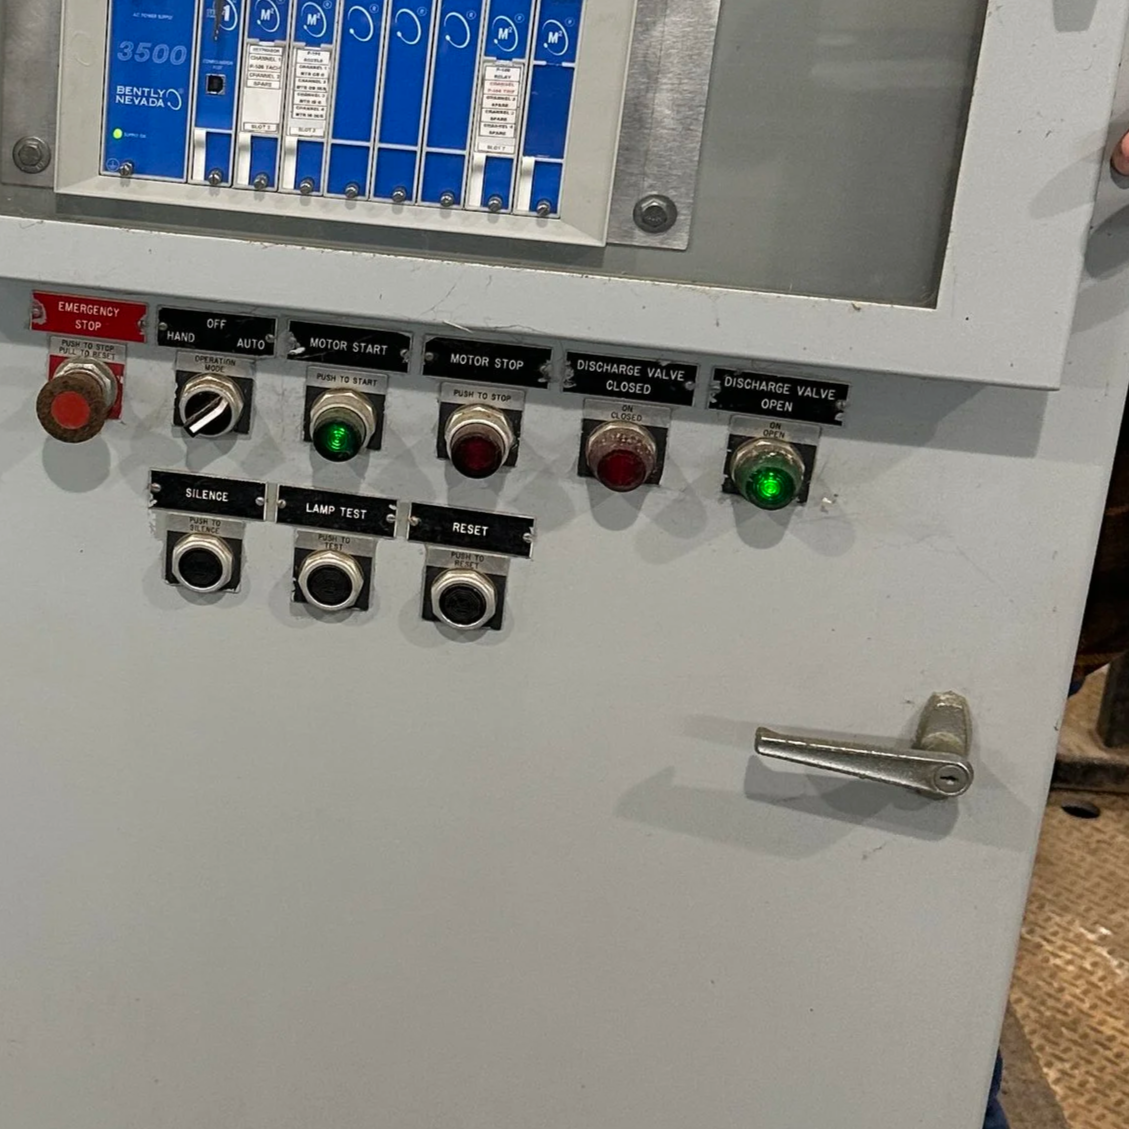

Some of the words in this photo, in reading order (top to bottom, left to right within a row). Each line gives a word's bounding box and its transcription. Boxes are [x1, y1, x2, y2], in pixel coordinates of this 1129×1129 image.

[117, 40, 188, 66] 3500
[116, 85, 166, 98] BENTLY
[116, 95, 164, 108] NEVADA
[58, 301, 120, 318] EMERGENCY
[75, 319, 102, 332] STOP
[207, 318, 226, 330] OFF
[167, 330, 195, 342] HAND
[62, 340, 81, 348] PUSH
[96, 343, 114, 352] STOP
[236, 338, 266, 350] AUTO
[310, 337, 348, 352] MOTOR
[352, 342, 388, 356] START
[59, 346, 76, 355] PULL
[79, 348, 90, 356] TO
[92, 350, 116, 360] RESET
[195, 355, 236, 366] OPERATION
[450, 354, 489, 368] MOTOR
[494, 358, 524, 371] STOP
[204, 364, 224, 372] MODE
[577, 360, 642, 376] DISCHARGE
[648, 366, 685, 382] VALVE
[316, 373, 336, 382] PUSH
[340, 376, 350, 384] TO
[352, 376, 378, 387] START
[606, 380, 652, 395] CLOSED
[724, 376, 791, 394] DISCHARGE
[797, 386, 836, 400] VALVE
[454, 389, 474, 398] PUSH
[478, 392, 488, 400] TO
[491, 392, 512, 402] STOP
[622, 404, 634, 413] ON
[761, 398, 793, 412] OPEN
[610, 412, 642, 422] CLOSED
[770, 422, 781, 430] ON
[763, 429, 786, 438] OPEN
[186, 488, 229, 502] SILENCE
[306, 502, 336, 516] LAMP
[340, 506, 367, 520] TEST
[189, 516, 208, 526] PUSH
[210, 519, 221, 527] TO
[189, 524, 220, 535] SILENCE
[452, 522, 489, 536] RESET
[318, 534, 338, 543] PUSH
[340, 536, 350, 544] TO
[324, 541, 344, 551] TEST
[450, 551, 470, 561] PUSH
[474, 554, 484, 562] TO
[454, 558, 480, 570] RESET
